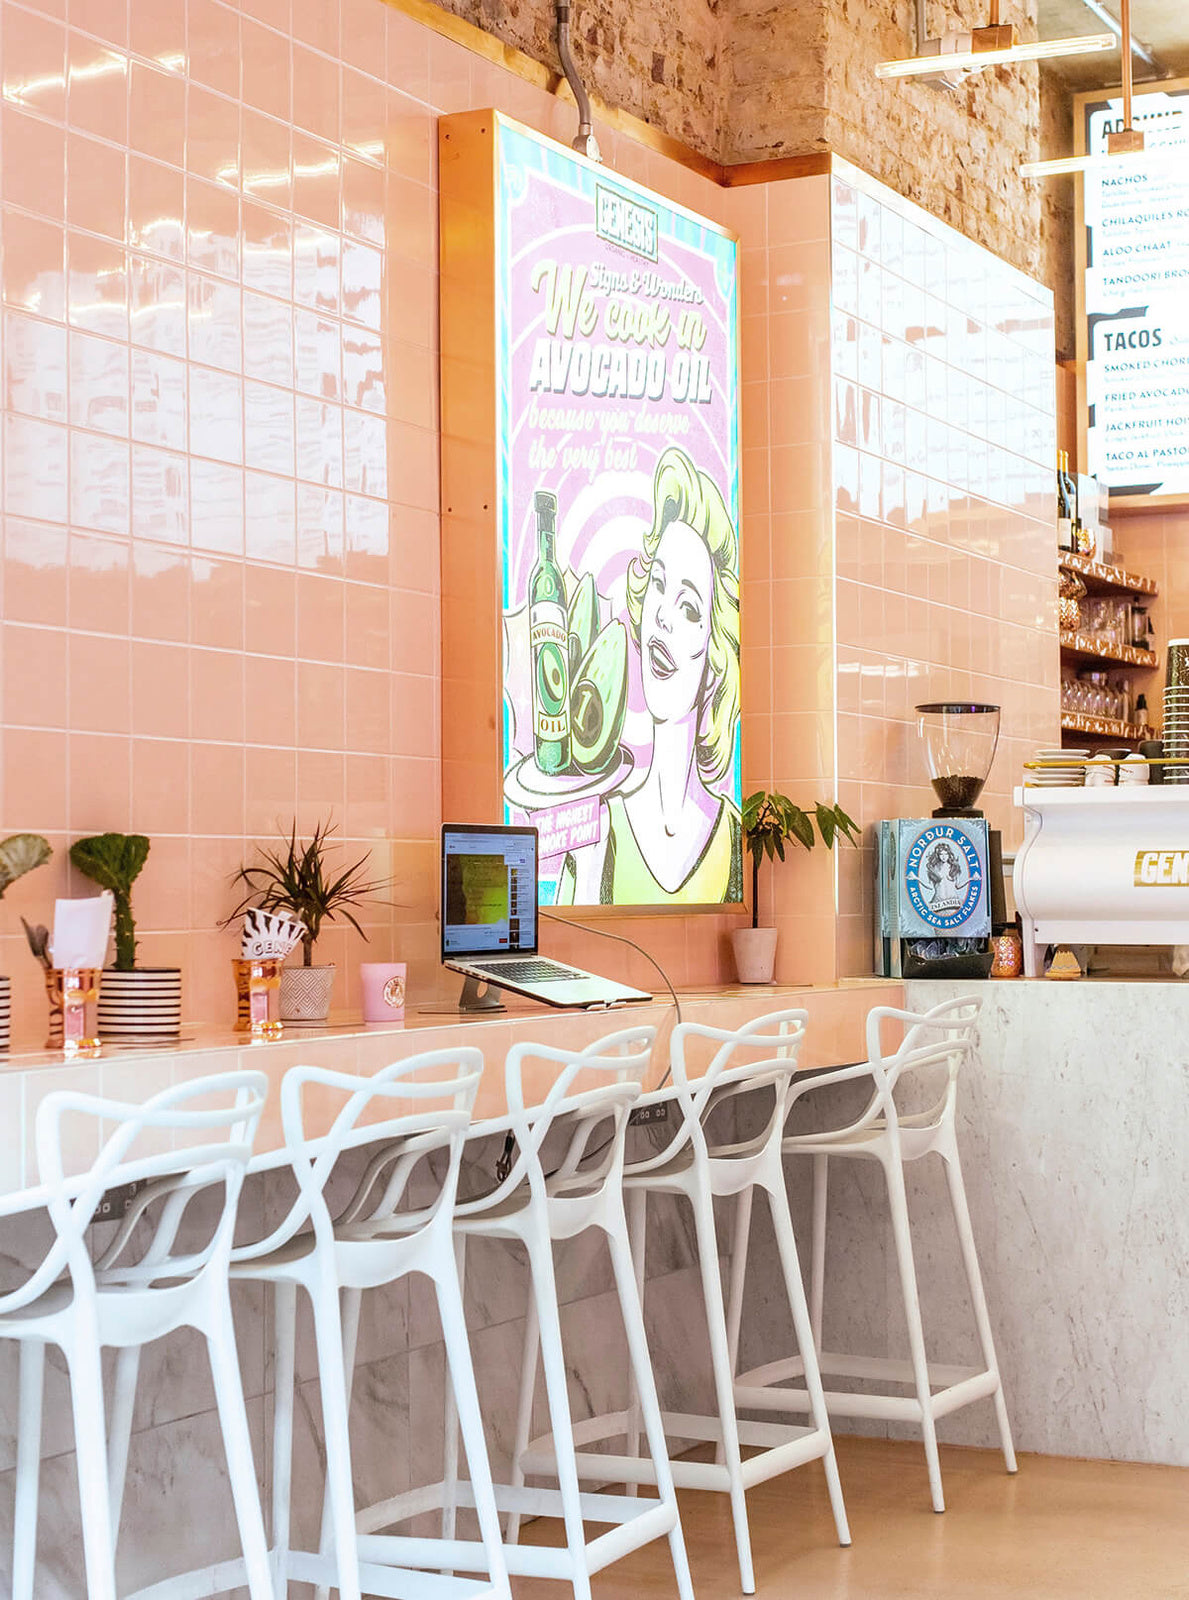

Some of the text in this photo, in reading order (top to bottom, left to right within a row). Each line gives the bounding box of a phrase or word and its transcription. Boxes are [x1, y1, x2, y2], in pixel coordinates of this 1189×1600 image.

[1101, 174, 1148, 187] NACHOS
[1101, 212, 1173, 228] CHILAQUILES
[1103, 245, 1133, 256] ALOO
[1135, 240, 1171, 253] CHAAT
[1103, 268, 1189, 286] TANDOORI BRO
[531, 258, 708, 352] We cook in
[1103, 328, 1162, 352] TACOS
[530, 337, 713, 405] AVOCADO OIL
[1104, 360, 1151, 373] SMOKED
[1105, 391, 1137, 402] FRIED
[528, 395, 596, 430] because
[598, 409, 631, 446] you
[1105, 416, 1189, 432] JACKFRUIT HOI
[528, 435, 638, 483] the very best
[1106, 446, 1189, 462] TACO AL PASTO
[532, 627, 566, 643] AVOCADO
[540, 719, 566, 733] OIL
[957, 836, 979, 869] SALT
[1140, 852, 1188, 884] GEN
[910, 886, 928, 916] ARCTIC
[926, 914, 942, 927] SEA
[944, 914, 963, 927] SALT
[963, 886, 979, 917] FLAKES
